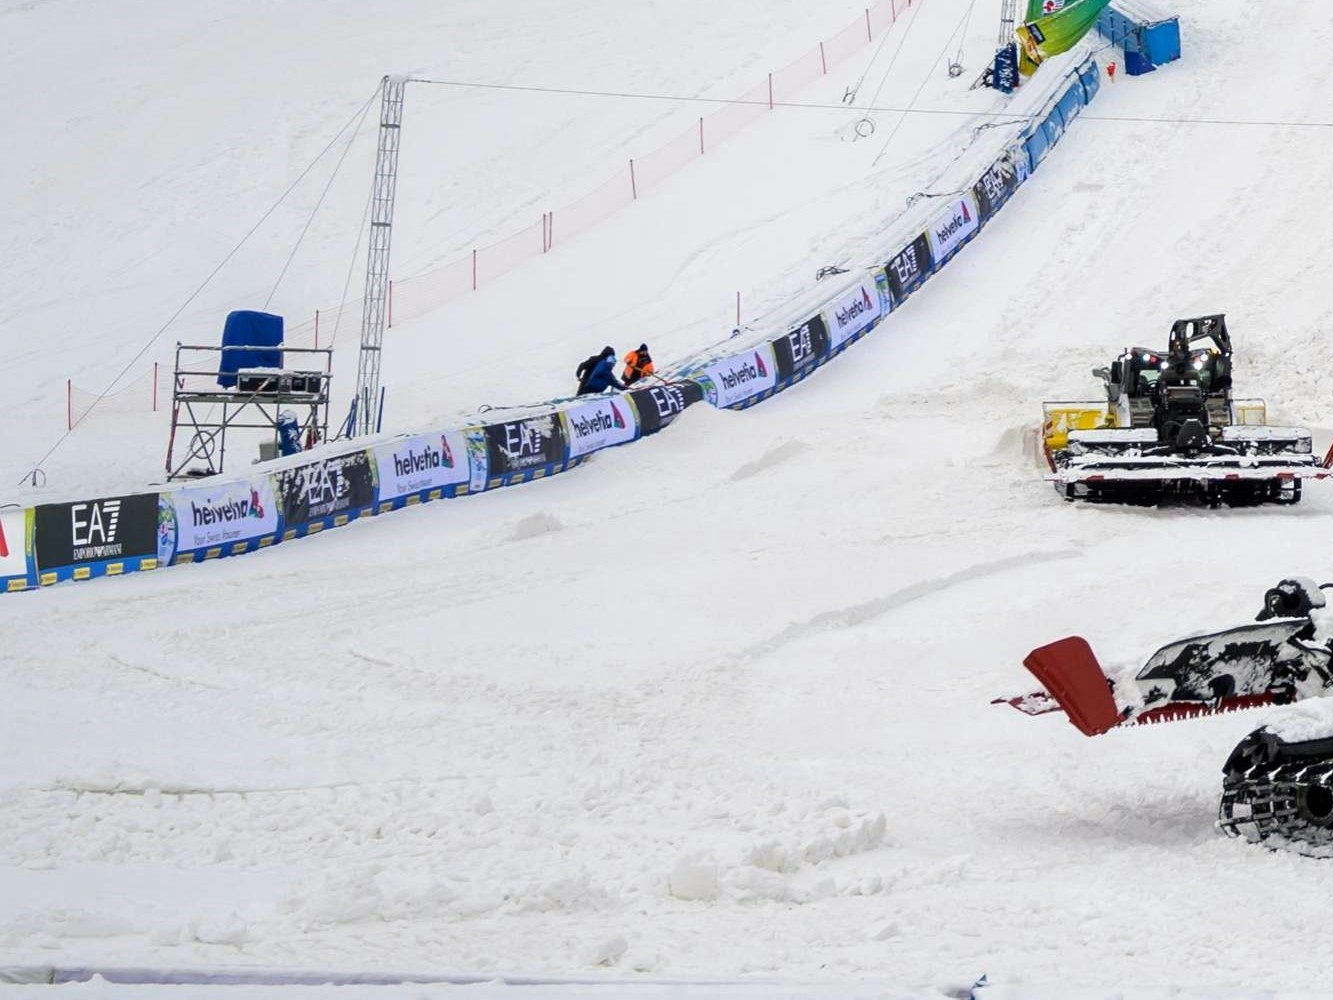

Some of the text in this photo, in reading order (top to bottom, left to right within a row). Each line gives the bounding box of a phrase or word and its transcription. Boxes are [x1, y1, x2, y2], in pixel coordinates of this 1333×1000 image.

[719, 361, 757, 390] helvetia
[571, 409, 612, 438] helvetia
[394, 445, 440, 478] helvetia
[71, 500, 121, 546] EA7
